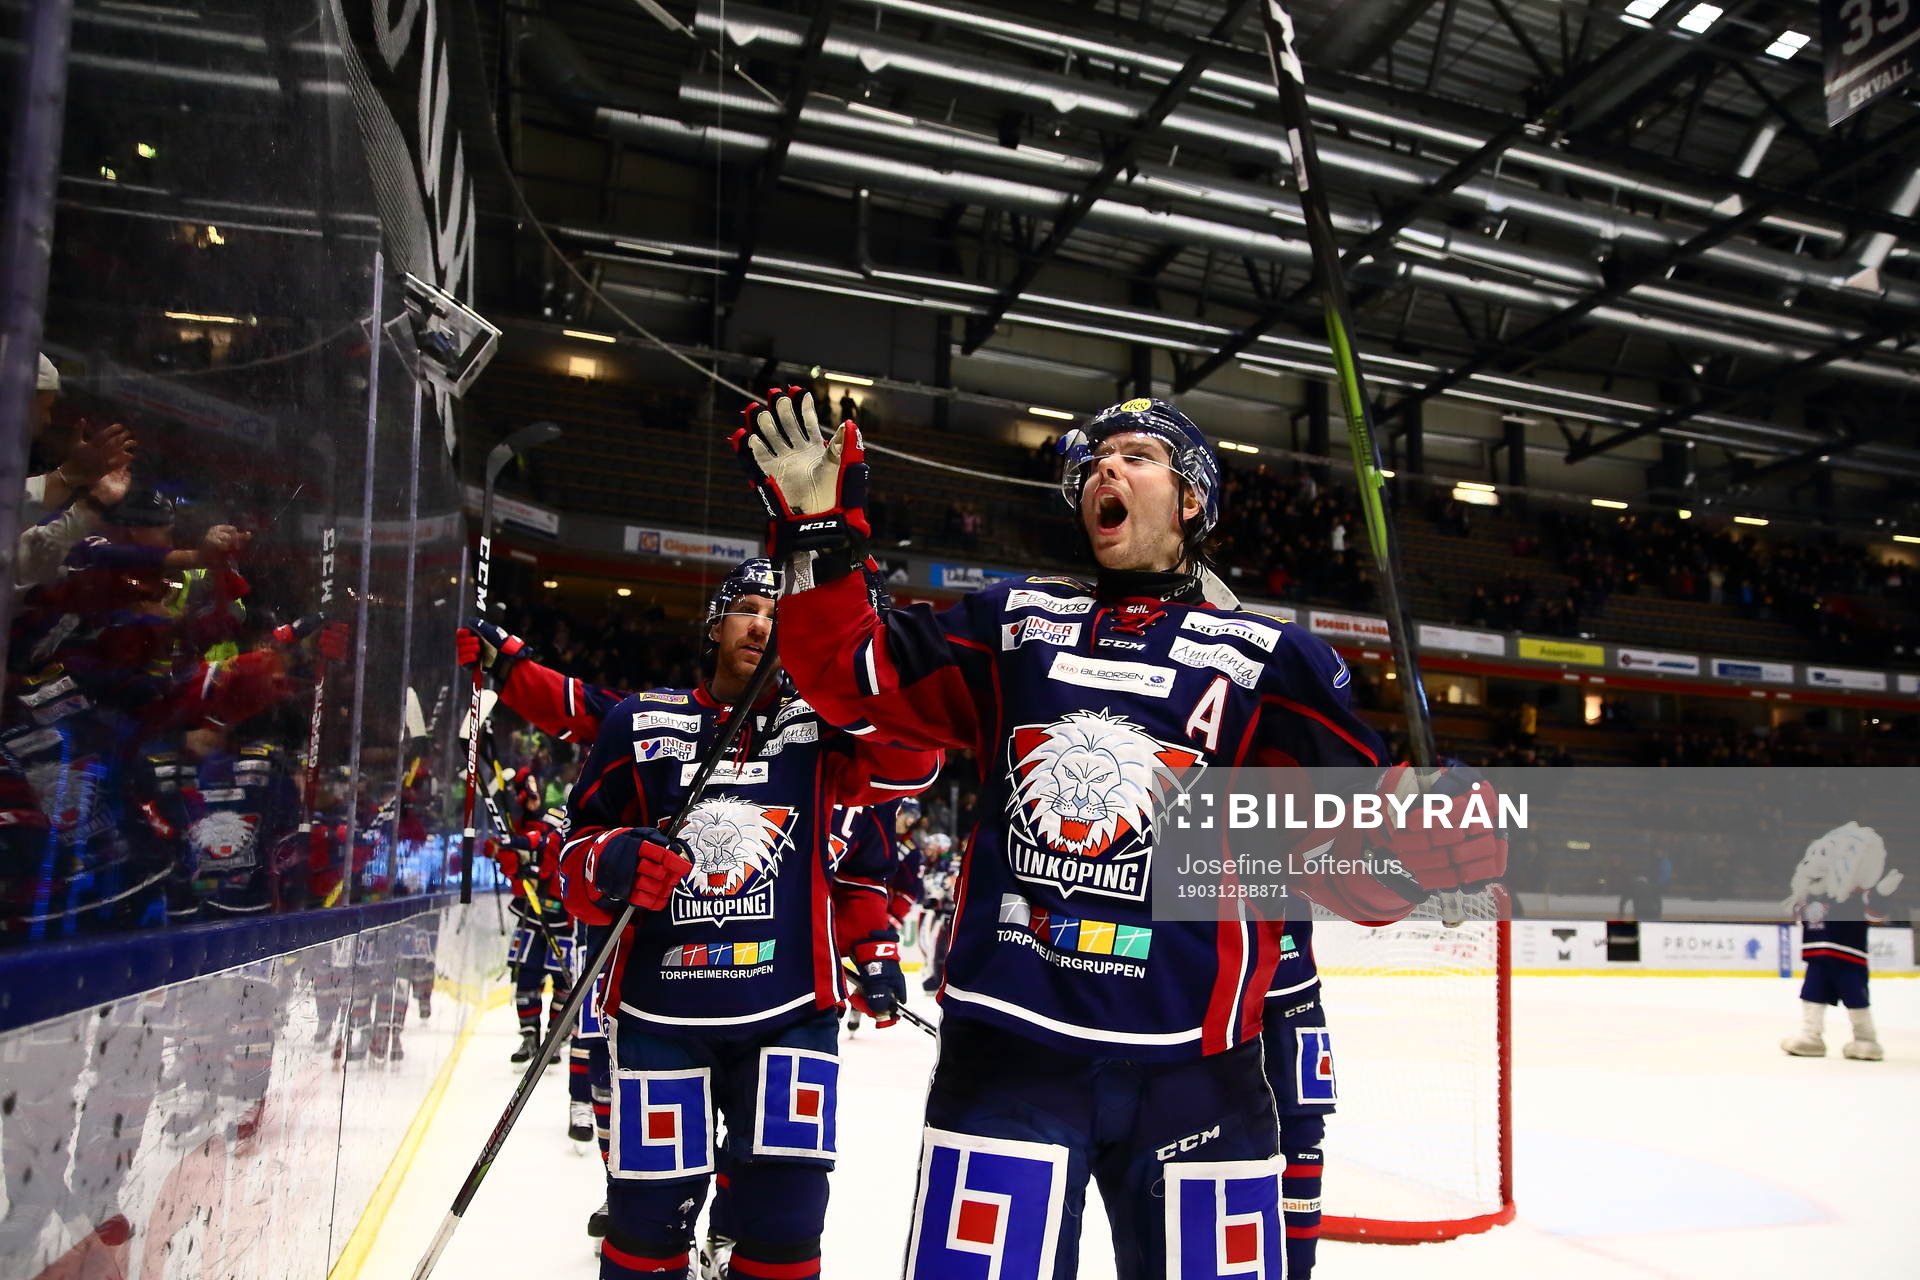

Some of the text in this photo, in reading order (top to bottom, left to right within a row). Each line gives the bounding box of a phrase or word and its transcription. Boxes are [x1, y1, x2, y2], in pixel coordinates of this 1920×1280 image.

[476, 536, 491, 612] CCM
[1125, 605, 1149, 614] SHL
[1028, 618, 1073, 634] INTER
[1025, 628, 1070, 643] SPORT
[1098, 638, 1146, 650] CCM
[1186, 675, 1231, 754] A
[467, 682, 481, 774] JETSPEED
[650, 715, 698, 732] Botrygg
[662, 738, 692, 751] INTER
[1015, 843, 1140, 892] LINKÖPING
[678, 893, 766, 919] LINKÖPING
[1663, 936, 1737, 952] PROMAS
[660, 965, 774, 980] TORPHEIMERGRUPPEN
[1284, 1001, 1315, 1018] CCM
[1155, 1125, 1221, 1162] CCM
